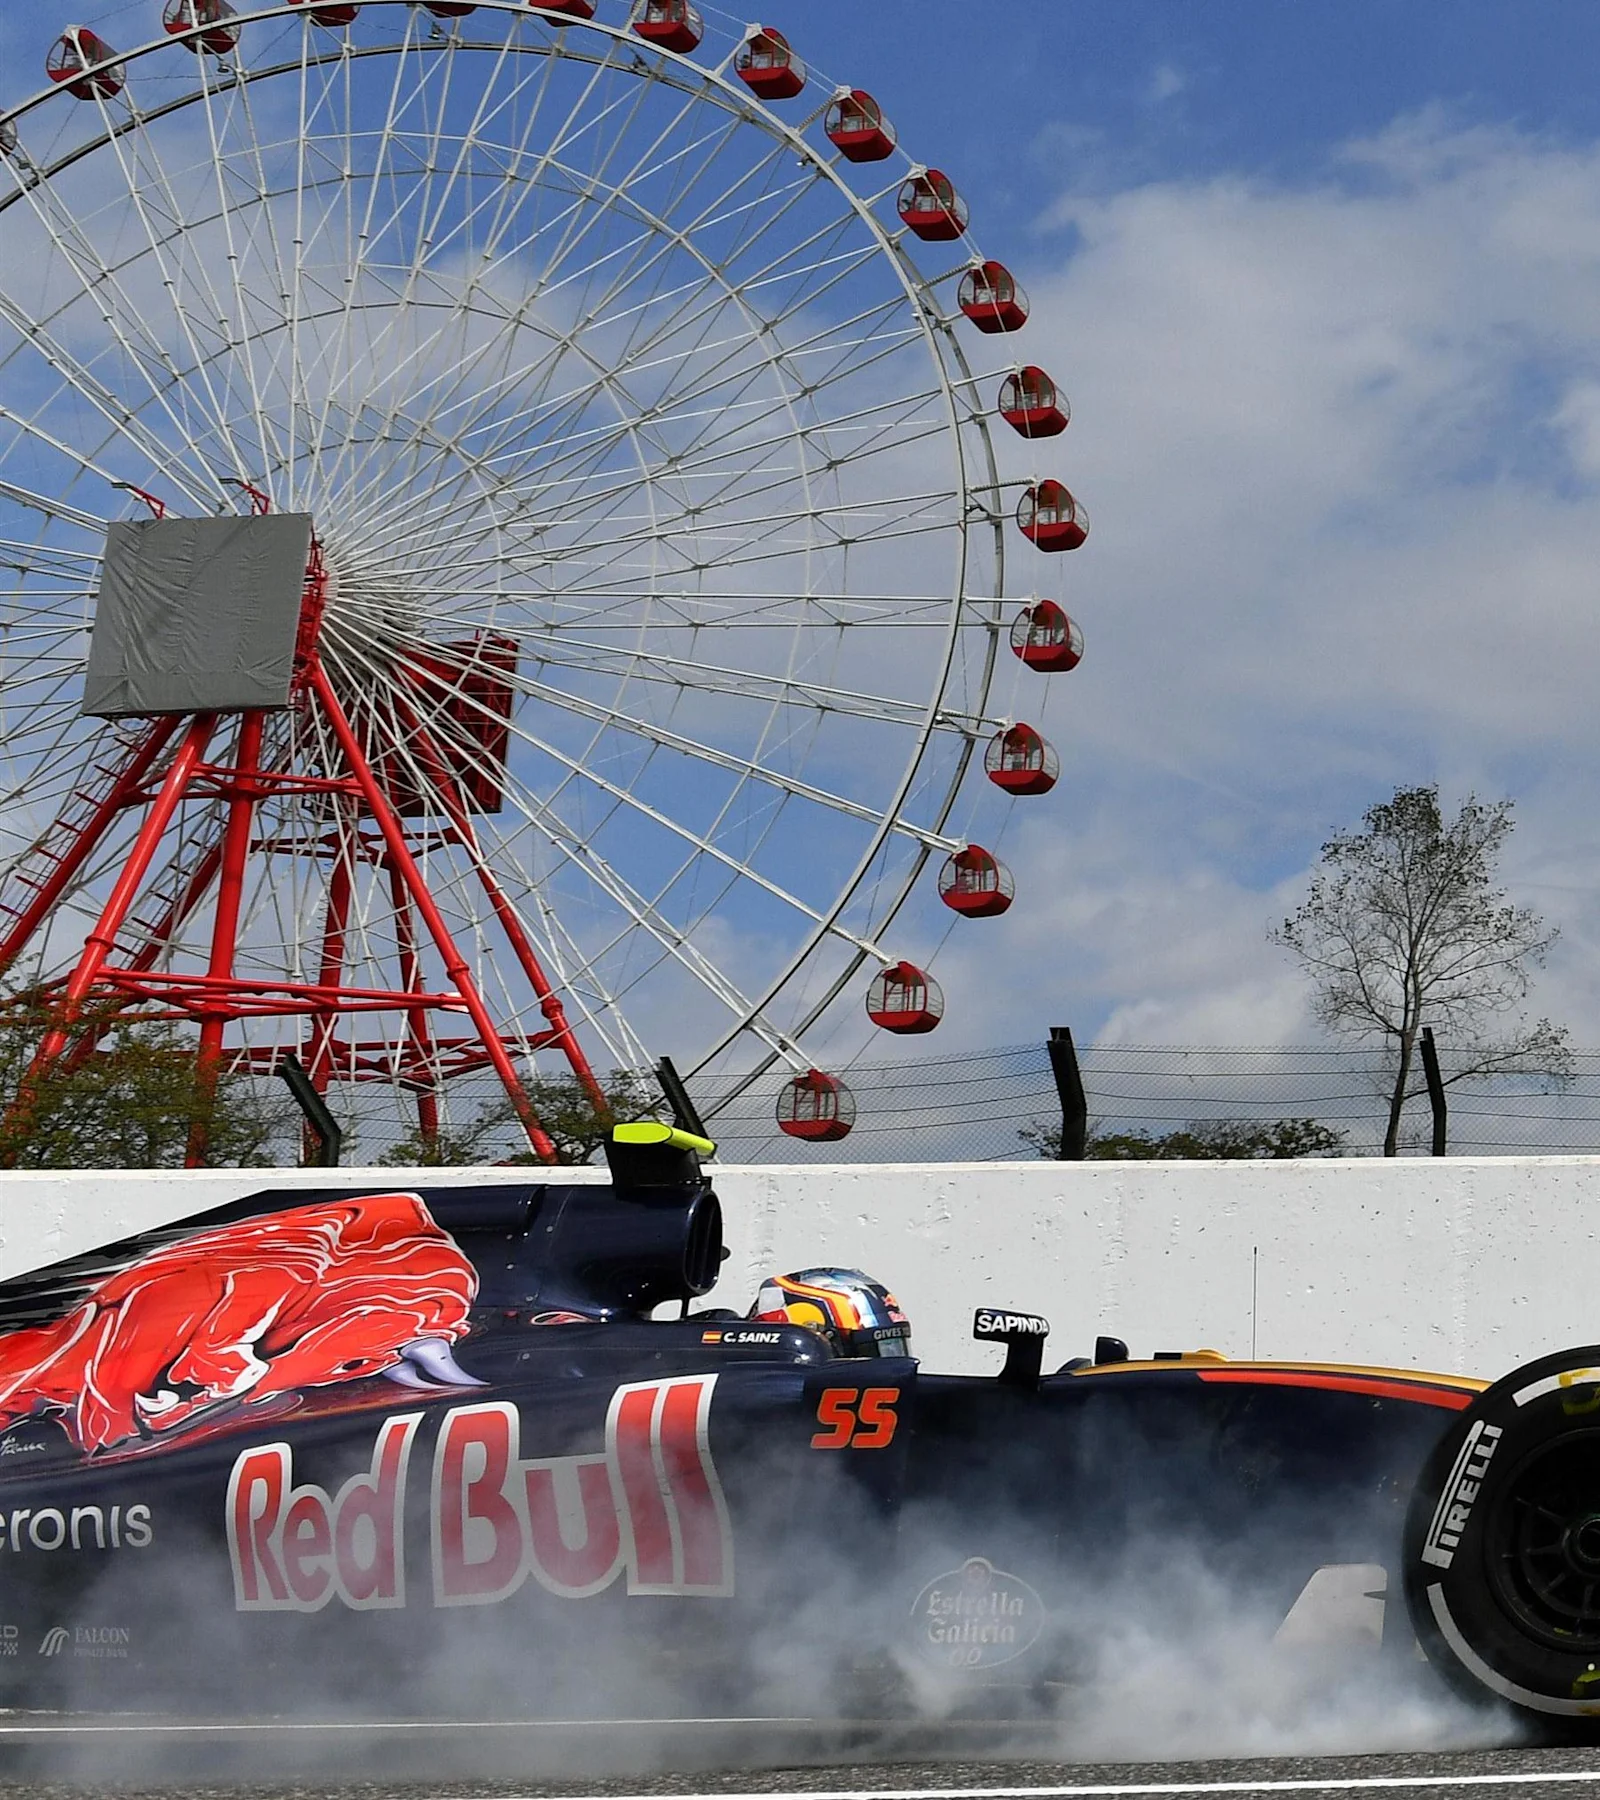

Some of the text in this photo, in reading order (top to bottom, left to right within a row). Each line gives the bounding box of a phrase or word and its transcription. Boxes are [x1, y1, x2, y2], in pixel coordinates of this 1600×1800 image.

[723, 1332, 781, 1344] C. SAINZ
[976, 1315, 1049, 1335] SAPINDA
[810, 1388, 900, 1449] 55
[225, 1373, 735, 1613] Red Bull
[1421, 1420, 1504, 1569] PIRELLI
[0, 1504, 153, 1552] ronis
[926, 1590, 1024, 1616] Estrella
[75, 1626, 130, 1644] FALCON
[928, 1617, 1016, 1644] Galicia
